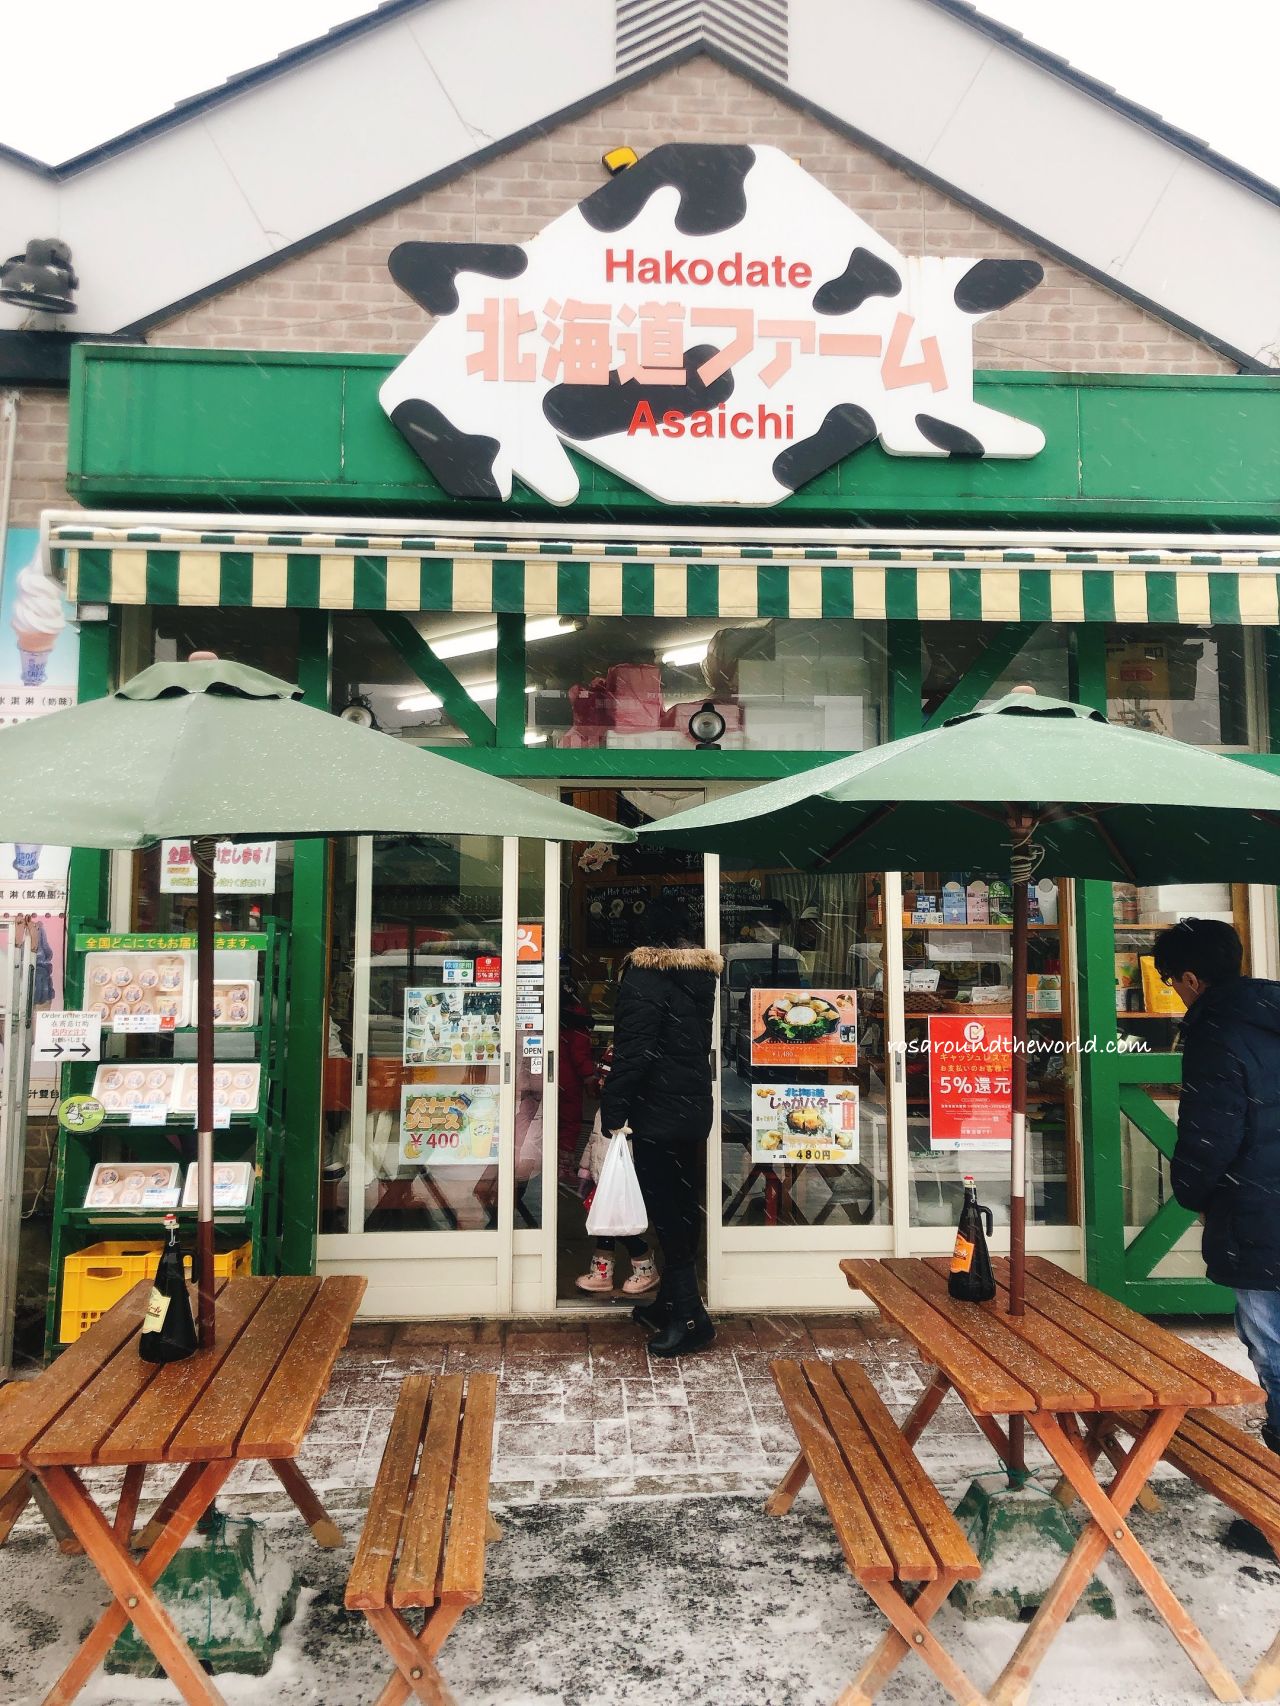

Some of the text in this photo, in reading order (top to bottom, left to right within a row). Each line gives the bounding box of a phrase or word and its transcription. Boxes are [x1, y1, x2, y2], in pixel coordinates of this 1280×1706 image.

[605, 248, 813, 288] Hakodate
[465, 297, 948, 393] 北海道ファーム
[626, 400, 795, 440] Asaichi
[86, 937, 256, 949] 全国どこにでもお届きます。
[523, 1047, 542, 1055] OPEN
[940, 1053, 1009, 1062] キャッシュレスで
[785, 1087, 825, 1097] 北海道
[940, 1076, 1011, 1094] 5%還元
[769, 1096, 840, 1109] じゃがバター
[406, 1112, 460, 1129] ジュース
[410, 1133, 459, 1148] ¥400
[796, 1149, 831, 1160] 480円
